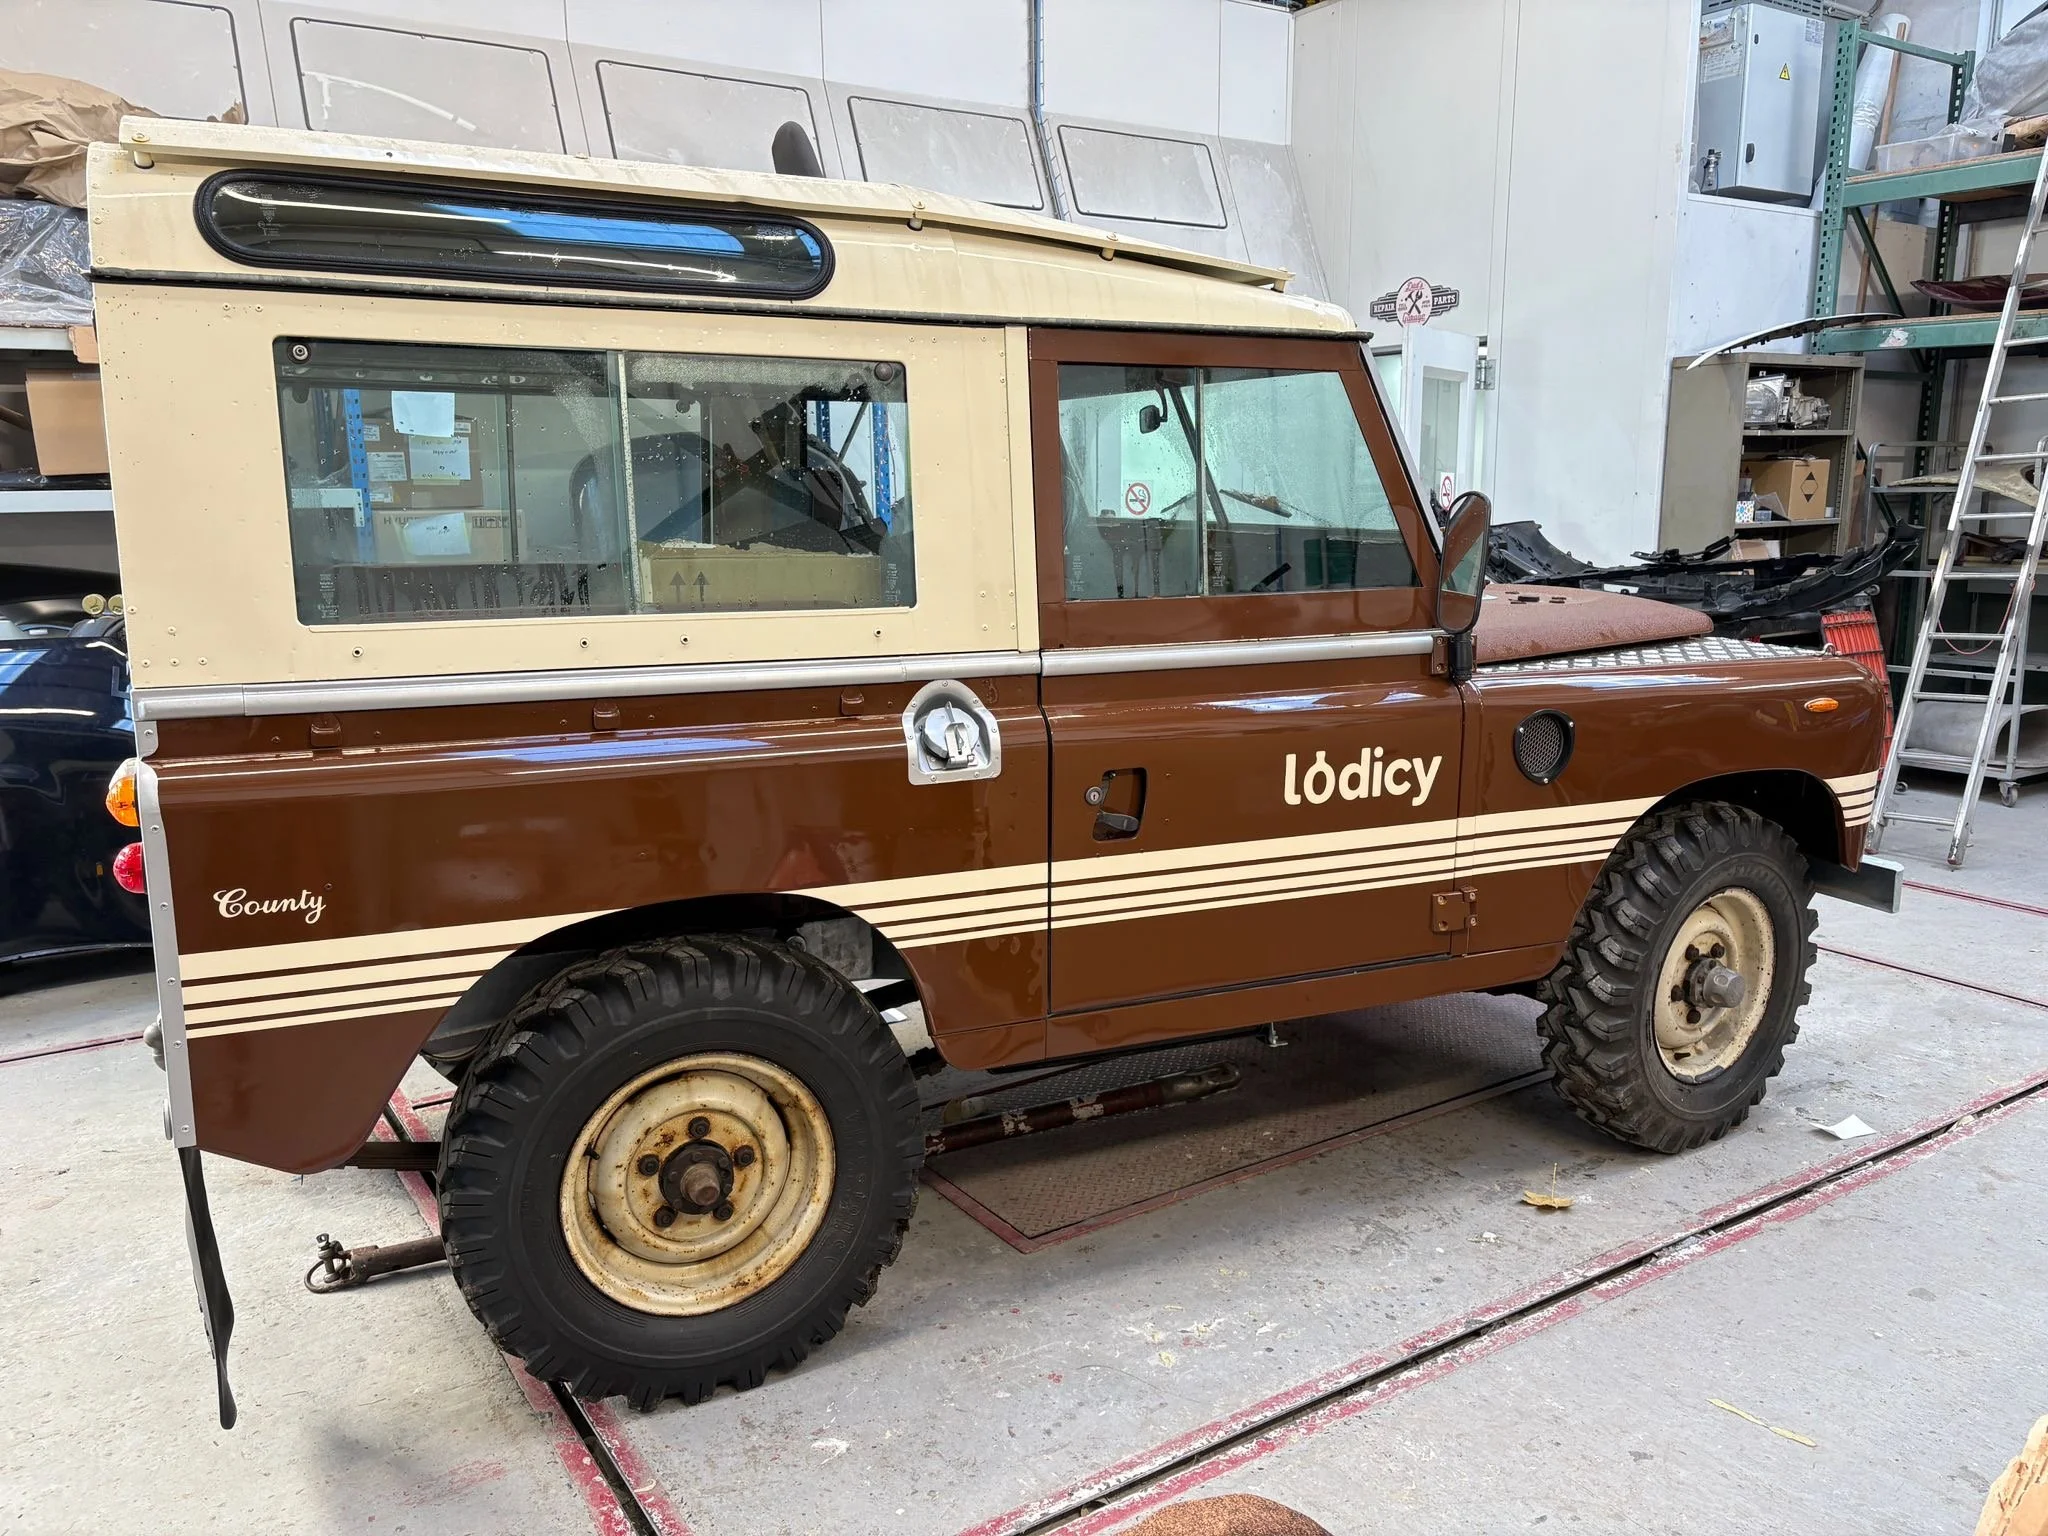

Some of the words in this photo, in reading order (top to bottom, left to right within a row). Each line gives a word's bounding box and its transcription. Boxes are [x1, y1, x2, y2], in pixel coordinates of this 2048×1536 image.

[1433, 294, 1456, 305] PARTS
[1373, 303, 1395, 313] REPAIR
[1402, 312, 1426, 324] Garage
[212, 887, 327, 925] County
